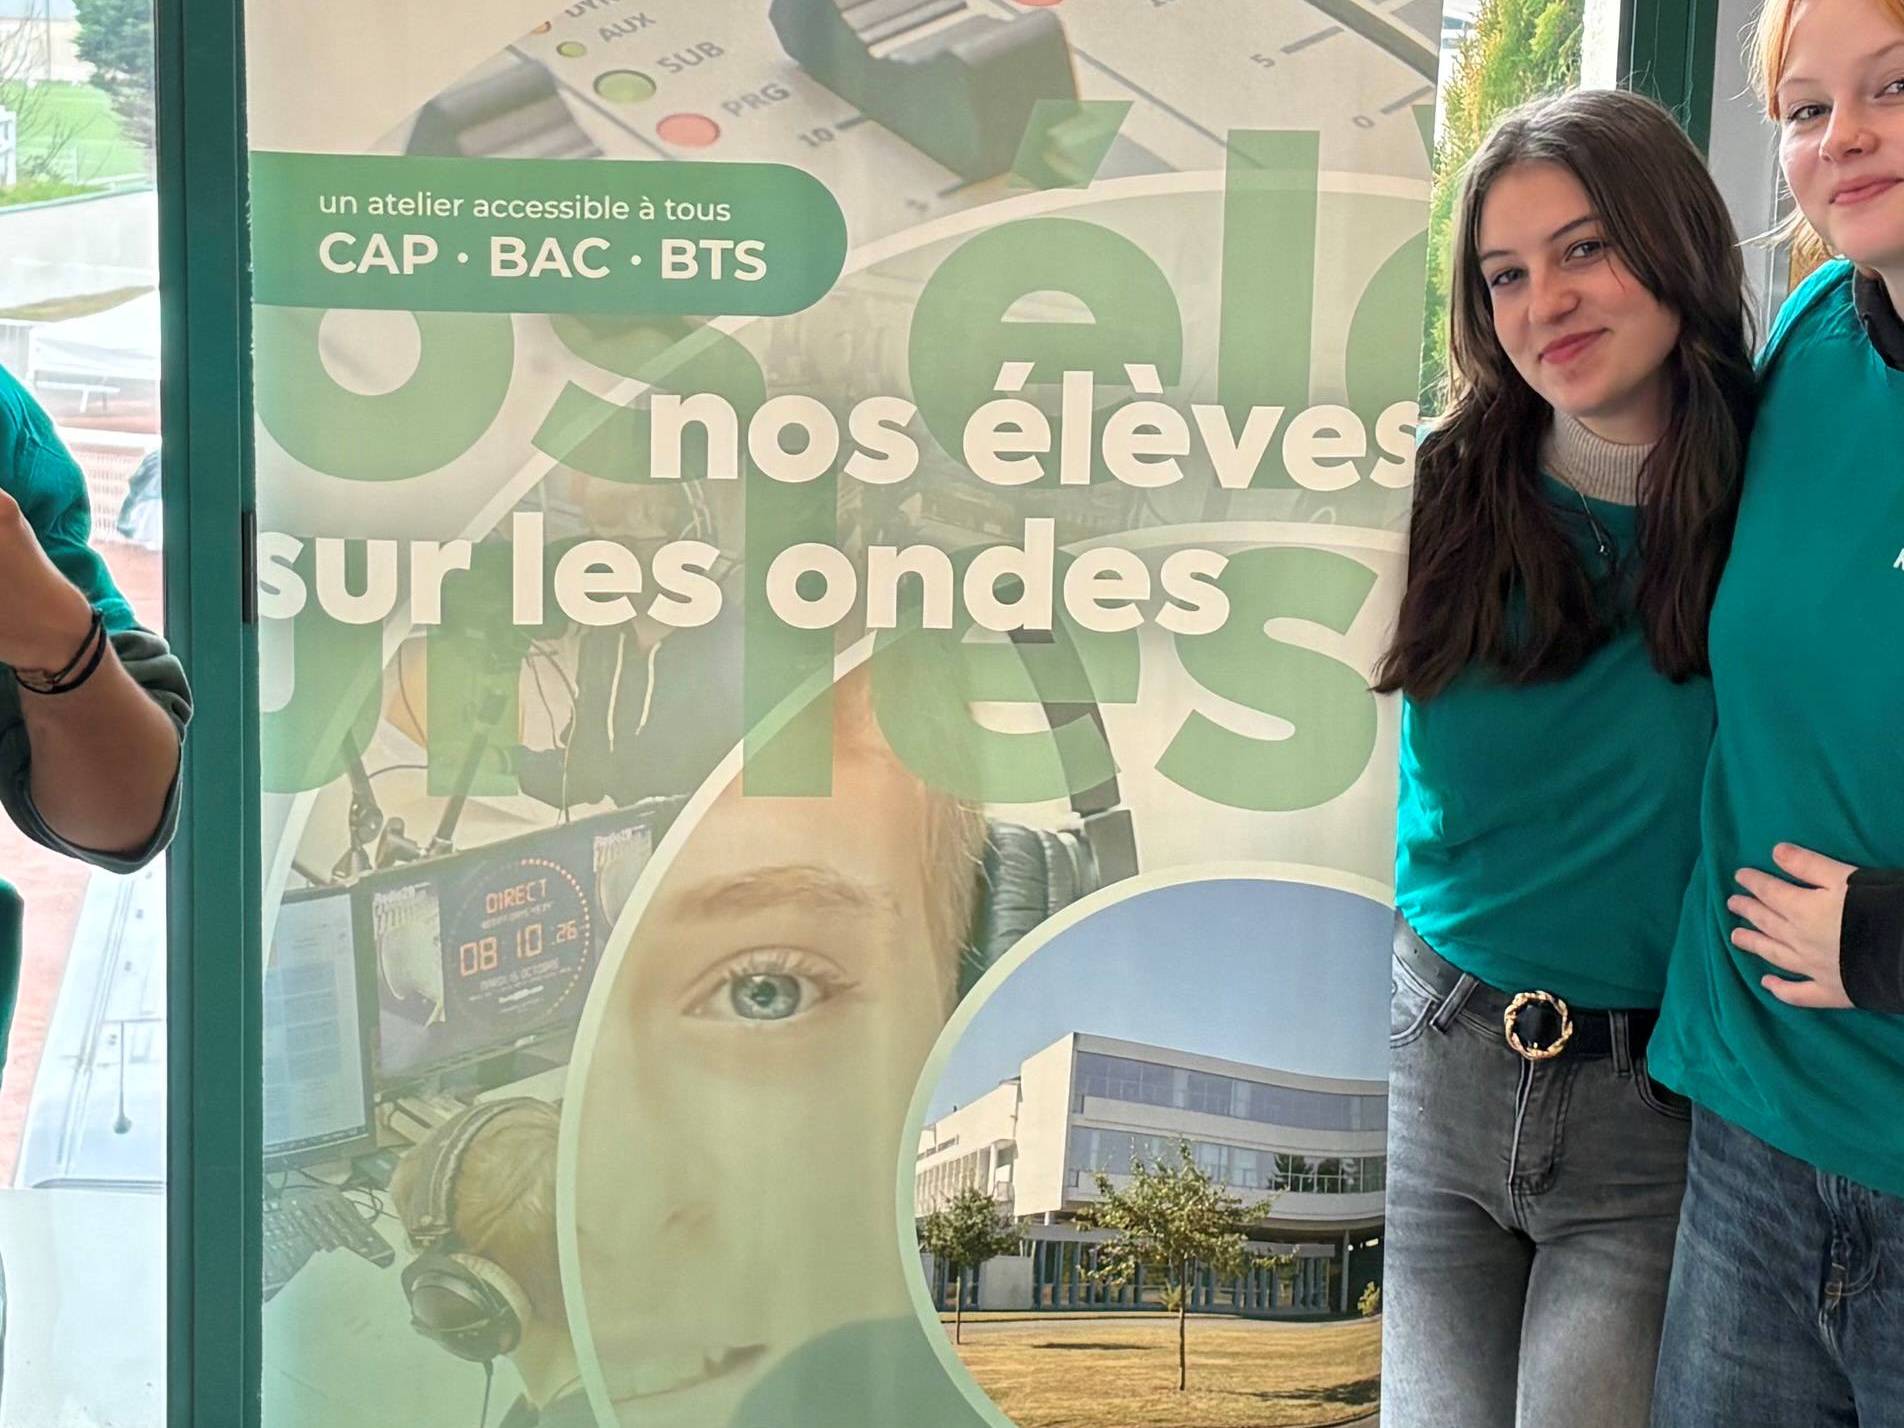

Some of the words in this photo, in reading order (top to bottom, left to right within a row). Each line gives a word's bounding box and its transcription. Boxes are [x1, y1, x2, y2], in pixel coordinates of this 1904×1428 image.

[597, 11, 657, 44] AUX
[656, 40, 726, 73] SUB
[1250, 53, 1276, 69] 5
[720, 82, 792, 117] PRG
[319, 195, 358, 214] un
[367, 191, 465, 217] atelier
[473, 194, 630, 220] accessible
[638, 195, 655, 220] à
[664, 198, 731, 222] tous
[319, 231, 439, 275] CAP
[490, 235, 611, 279] BAC
[661, 238, 767, 281] BTS
[649, 388, 920, 484] nos
[961, 361, 1421, 492] élèves
[256, 528, 472, 628] sur
[512, 511, 723, 630] les
[765, 518, 1230, 637] ondes
[485, 878, 548, 914] DIRECT
